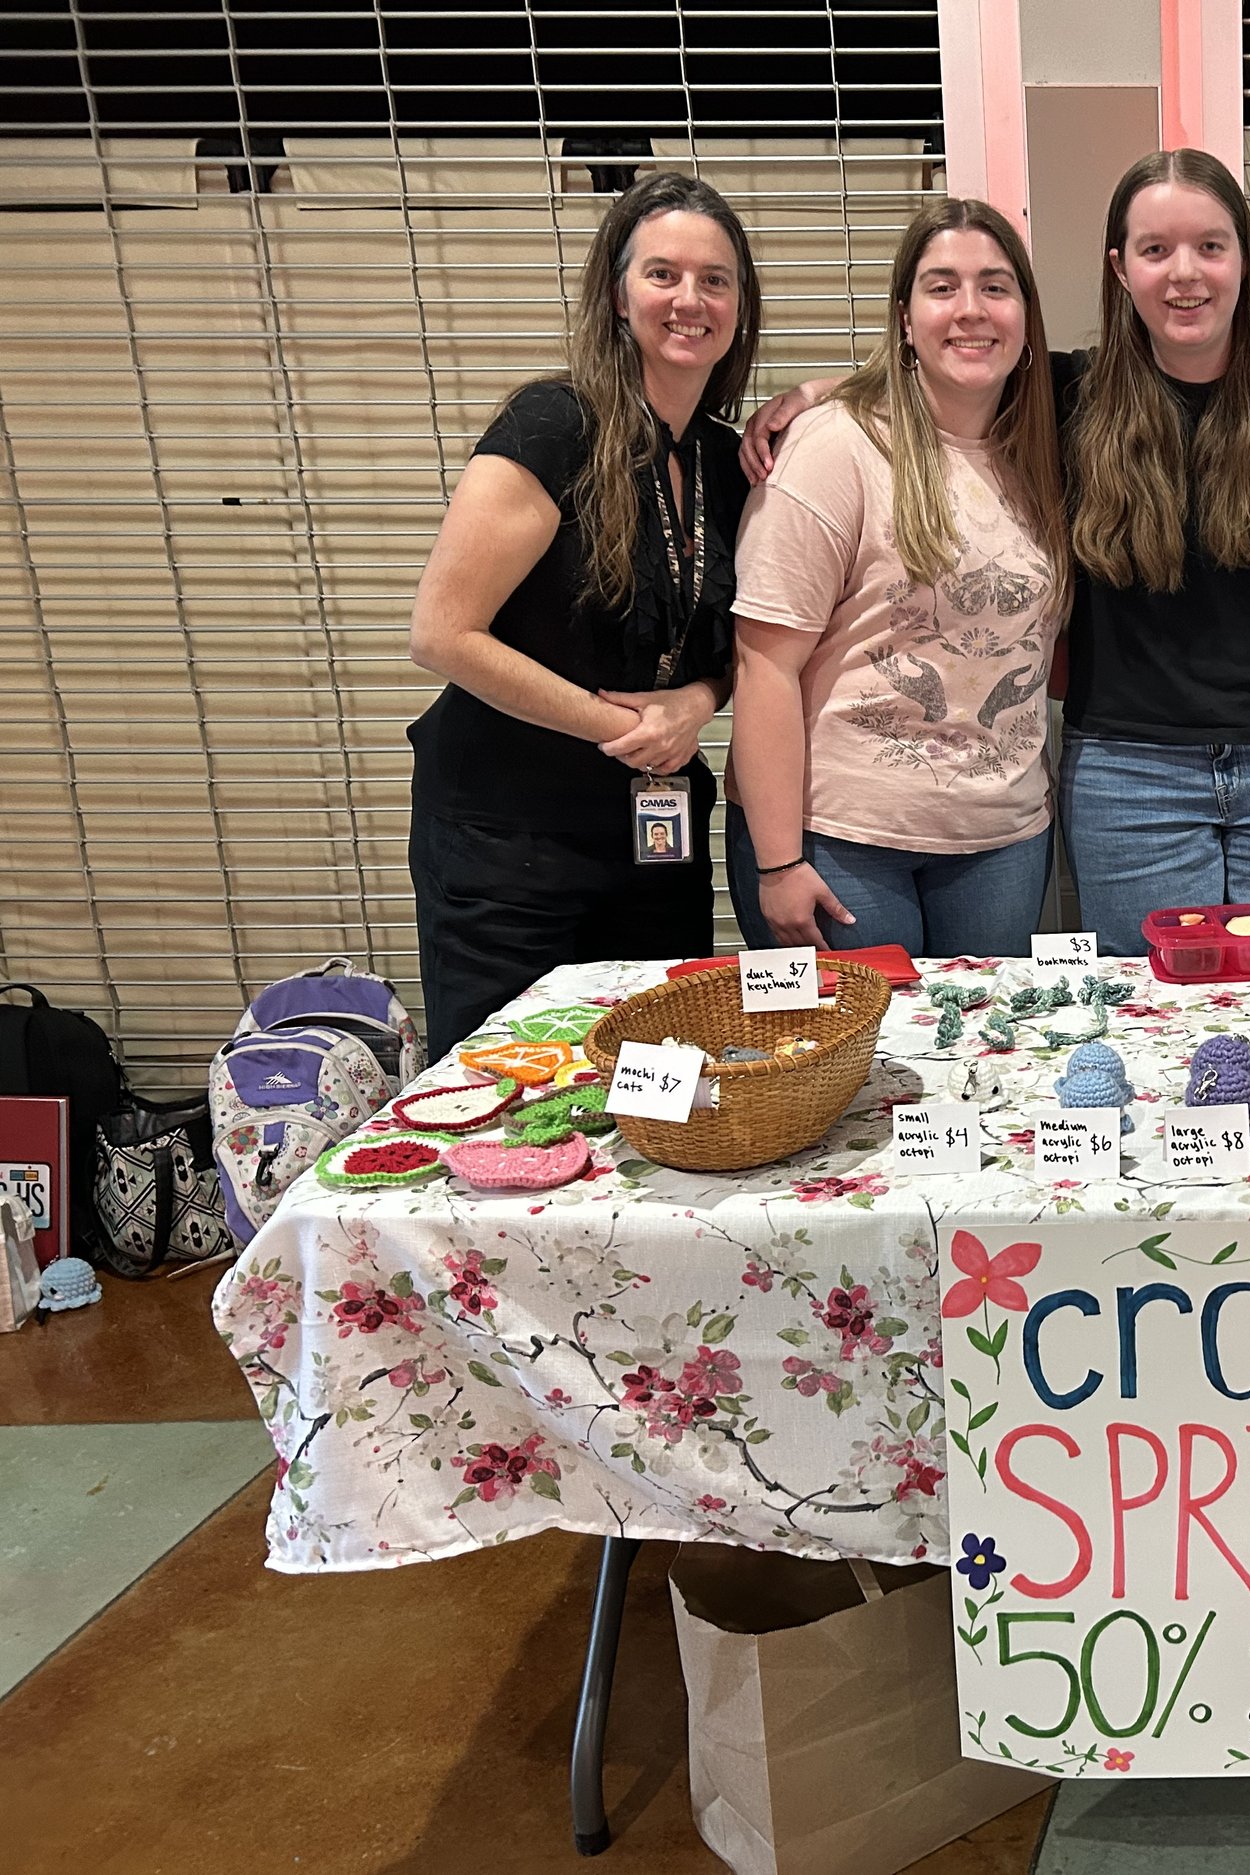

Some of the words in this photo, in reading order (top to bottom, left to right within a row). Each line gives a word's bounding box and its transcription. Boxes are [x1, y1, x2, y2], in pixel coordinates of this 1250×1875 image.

[640, 799, 677, 808] CAMAS
[1069, 937, 1092, 953] $3
[789, 961, 809, 978] $7
[1036, 956, 1089, 967] bookmarks
[746, 968, 774, 980] duck
[746, 977, 801, 995] keychains
[616, 1081, 643, 1092] cats
[620, 1066, 655, 1082] mochi
[659, 1073, 682, 1093] $7
[897, 1111, 930, 1124] small
[1040, 1119, 1088, 1132] medium
[898, 1130, 939, 1148] acrylic
[945, 1126, 968, 1148] $4
[1171, 1125, 1206, 1142] large
[1042, 1135, 1082, 1153] acrylic
[1090, 1133, 1112, 1155] $6
[1170, 1135, 1217, 1155] acrylic
[1221, 1130, 1244, 1152] $8
[899, 1145, 935, 1159] octopi
[1043, 1150, 1079, 1165] octopi
[1172, 1151, 1214, 1167] octopi
[995, 1609, 1217, 1740] 50%
